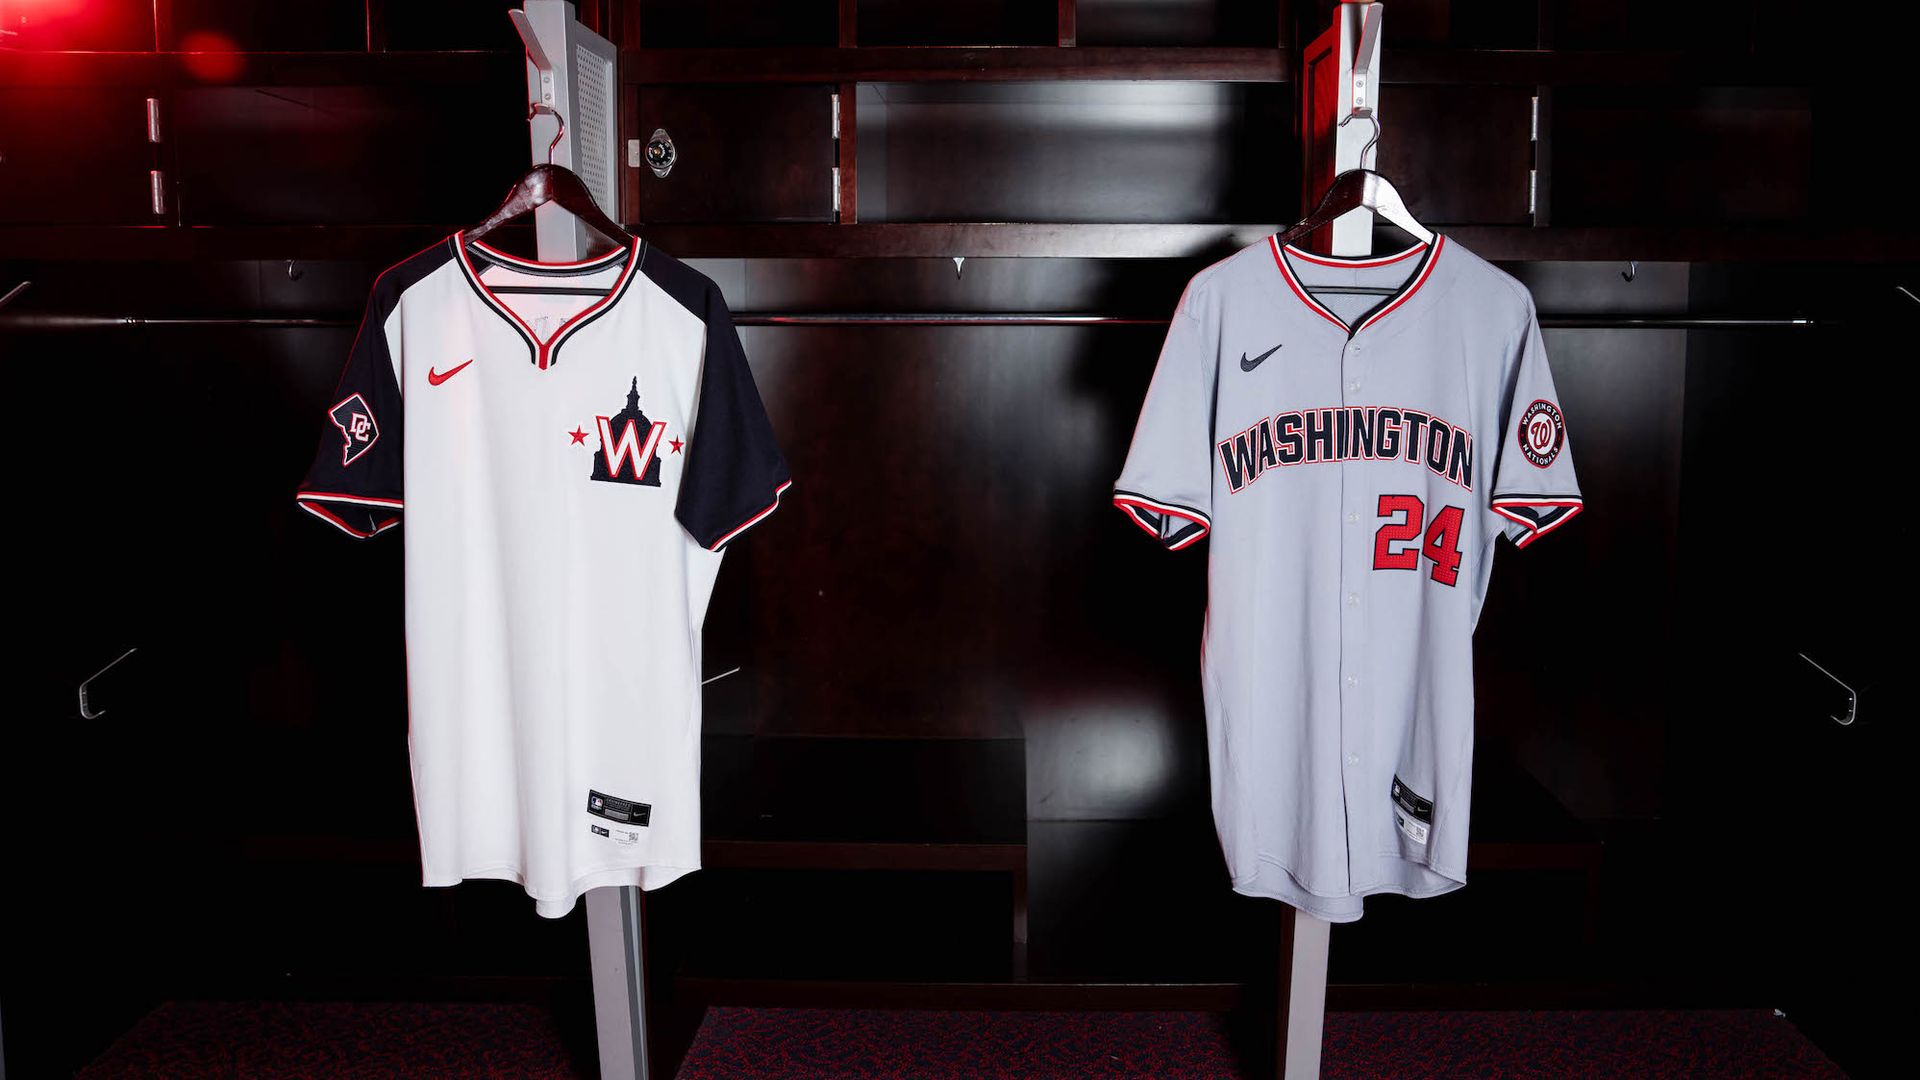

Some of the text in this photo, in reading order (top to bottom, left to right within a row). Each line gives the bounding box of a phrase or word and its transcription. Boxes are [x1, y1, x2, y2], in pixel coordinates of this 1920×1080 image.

[348, 412, 372, 442] DC
[1522, 403, 1562, 429] WASHINGTON
[596, 415, 667, 481] W
[1217, 406, 1473, 495] WASHINGTON
[1523, 443, 1558, 465] NATIONALS
[1372, 494, 1465, 588] 24
